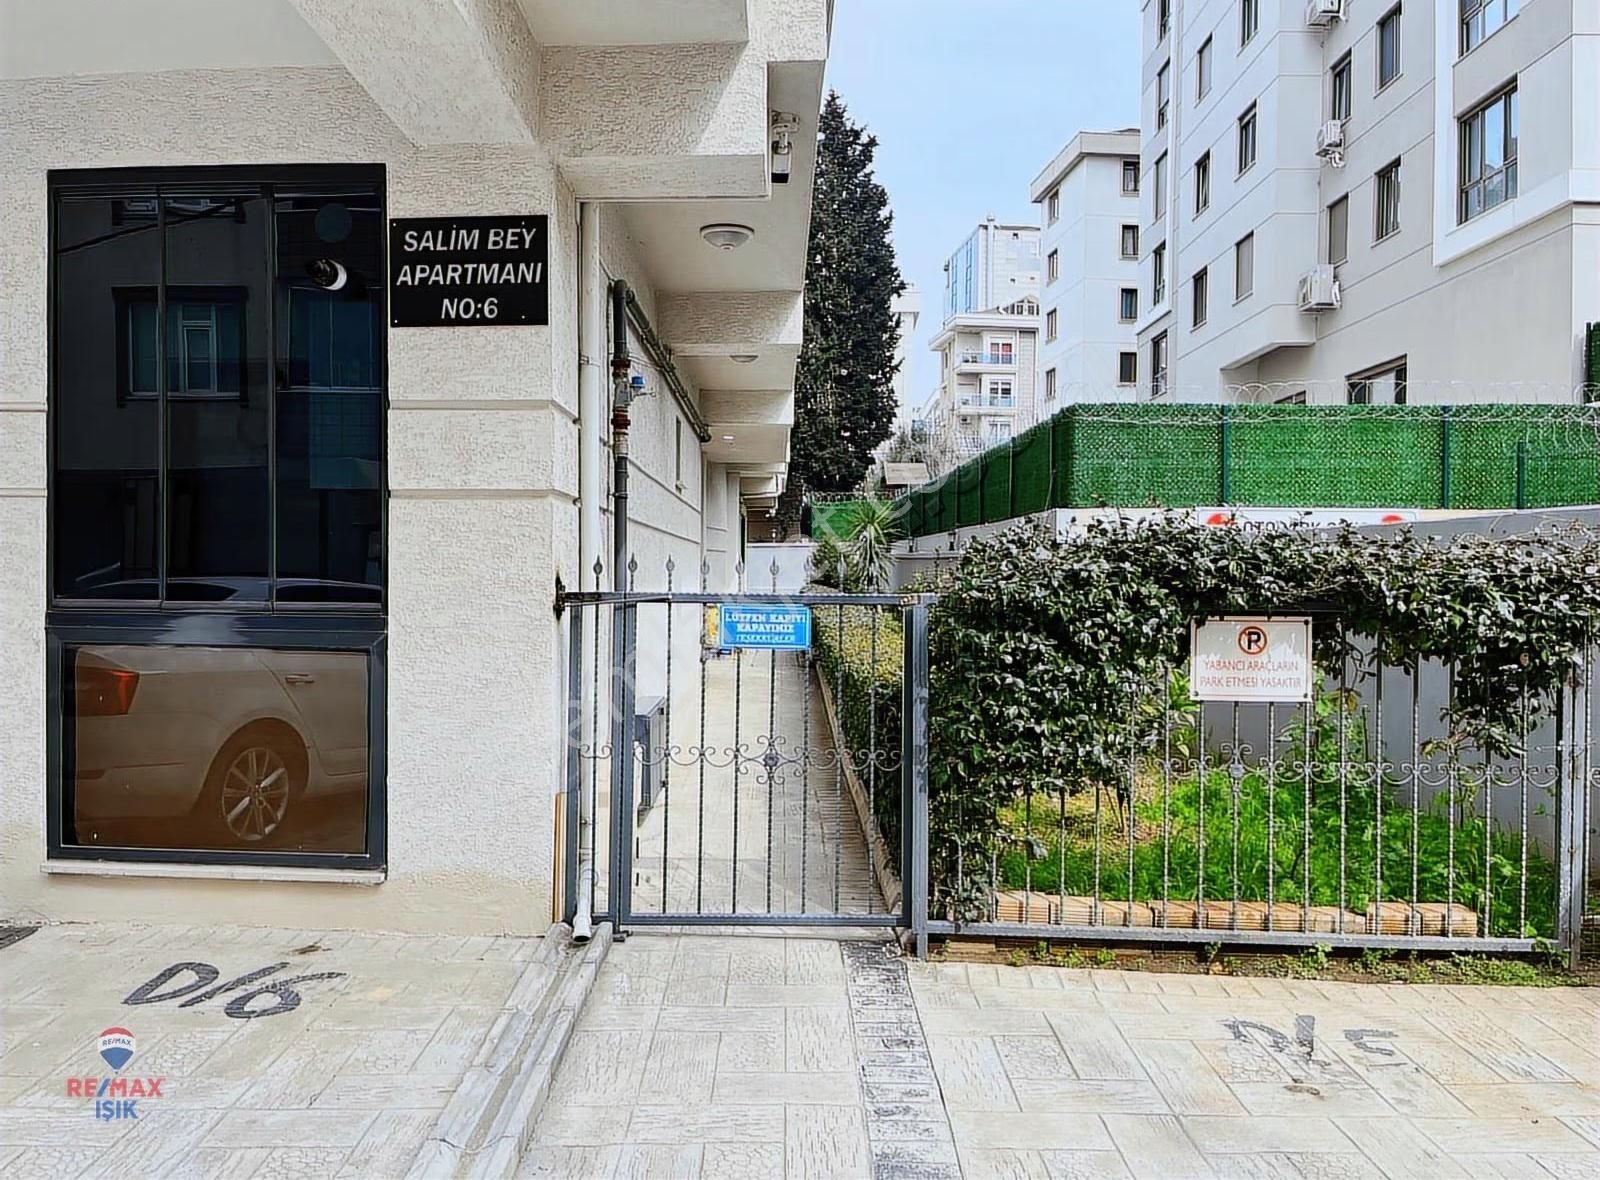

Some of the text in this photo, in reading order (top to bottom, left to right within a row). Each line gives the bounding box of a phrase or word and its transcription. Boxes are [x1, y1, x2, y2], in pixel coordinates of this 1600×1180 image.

[403, 224, 537, 252] SALİM BEY
[396, 262, 543, 286] APARTMANI
[441, 297, 498, 319] NO:6
[1205, 660, 1245, 672] YABANCI
[1200, 676, 1224, 688] PARK
[1260, 677, 1302, 689] YASAKTIR
